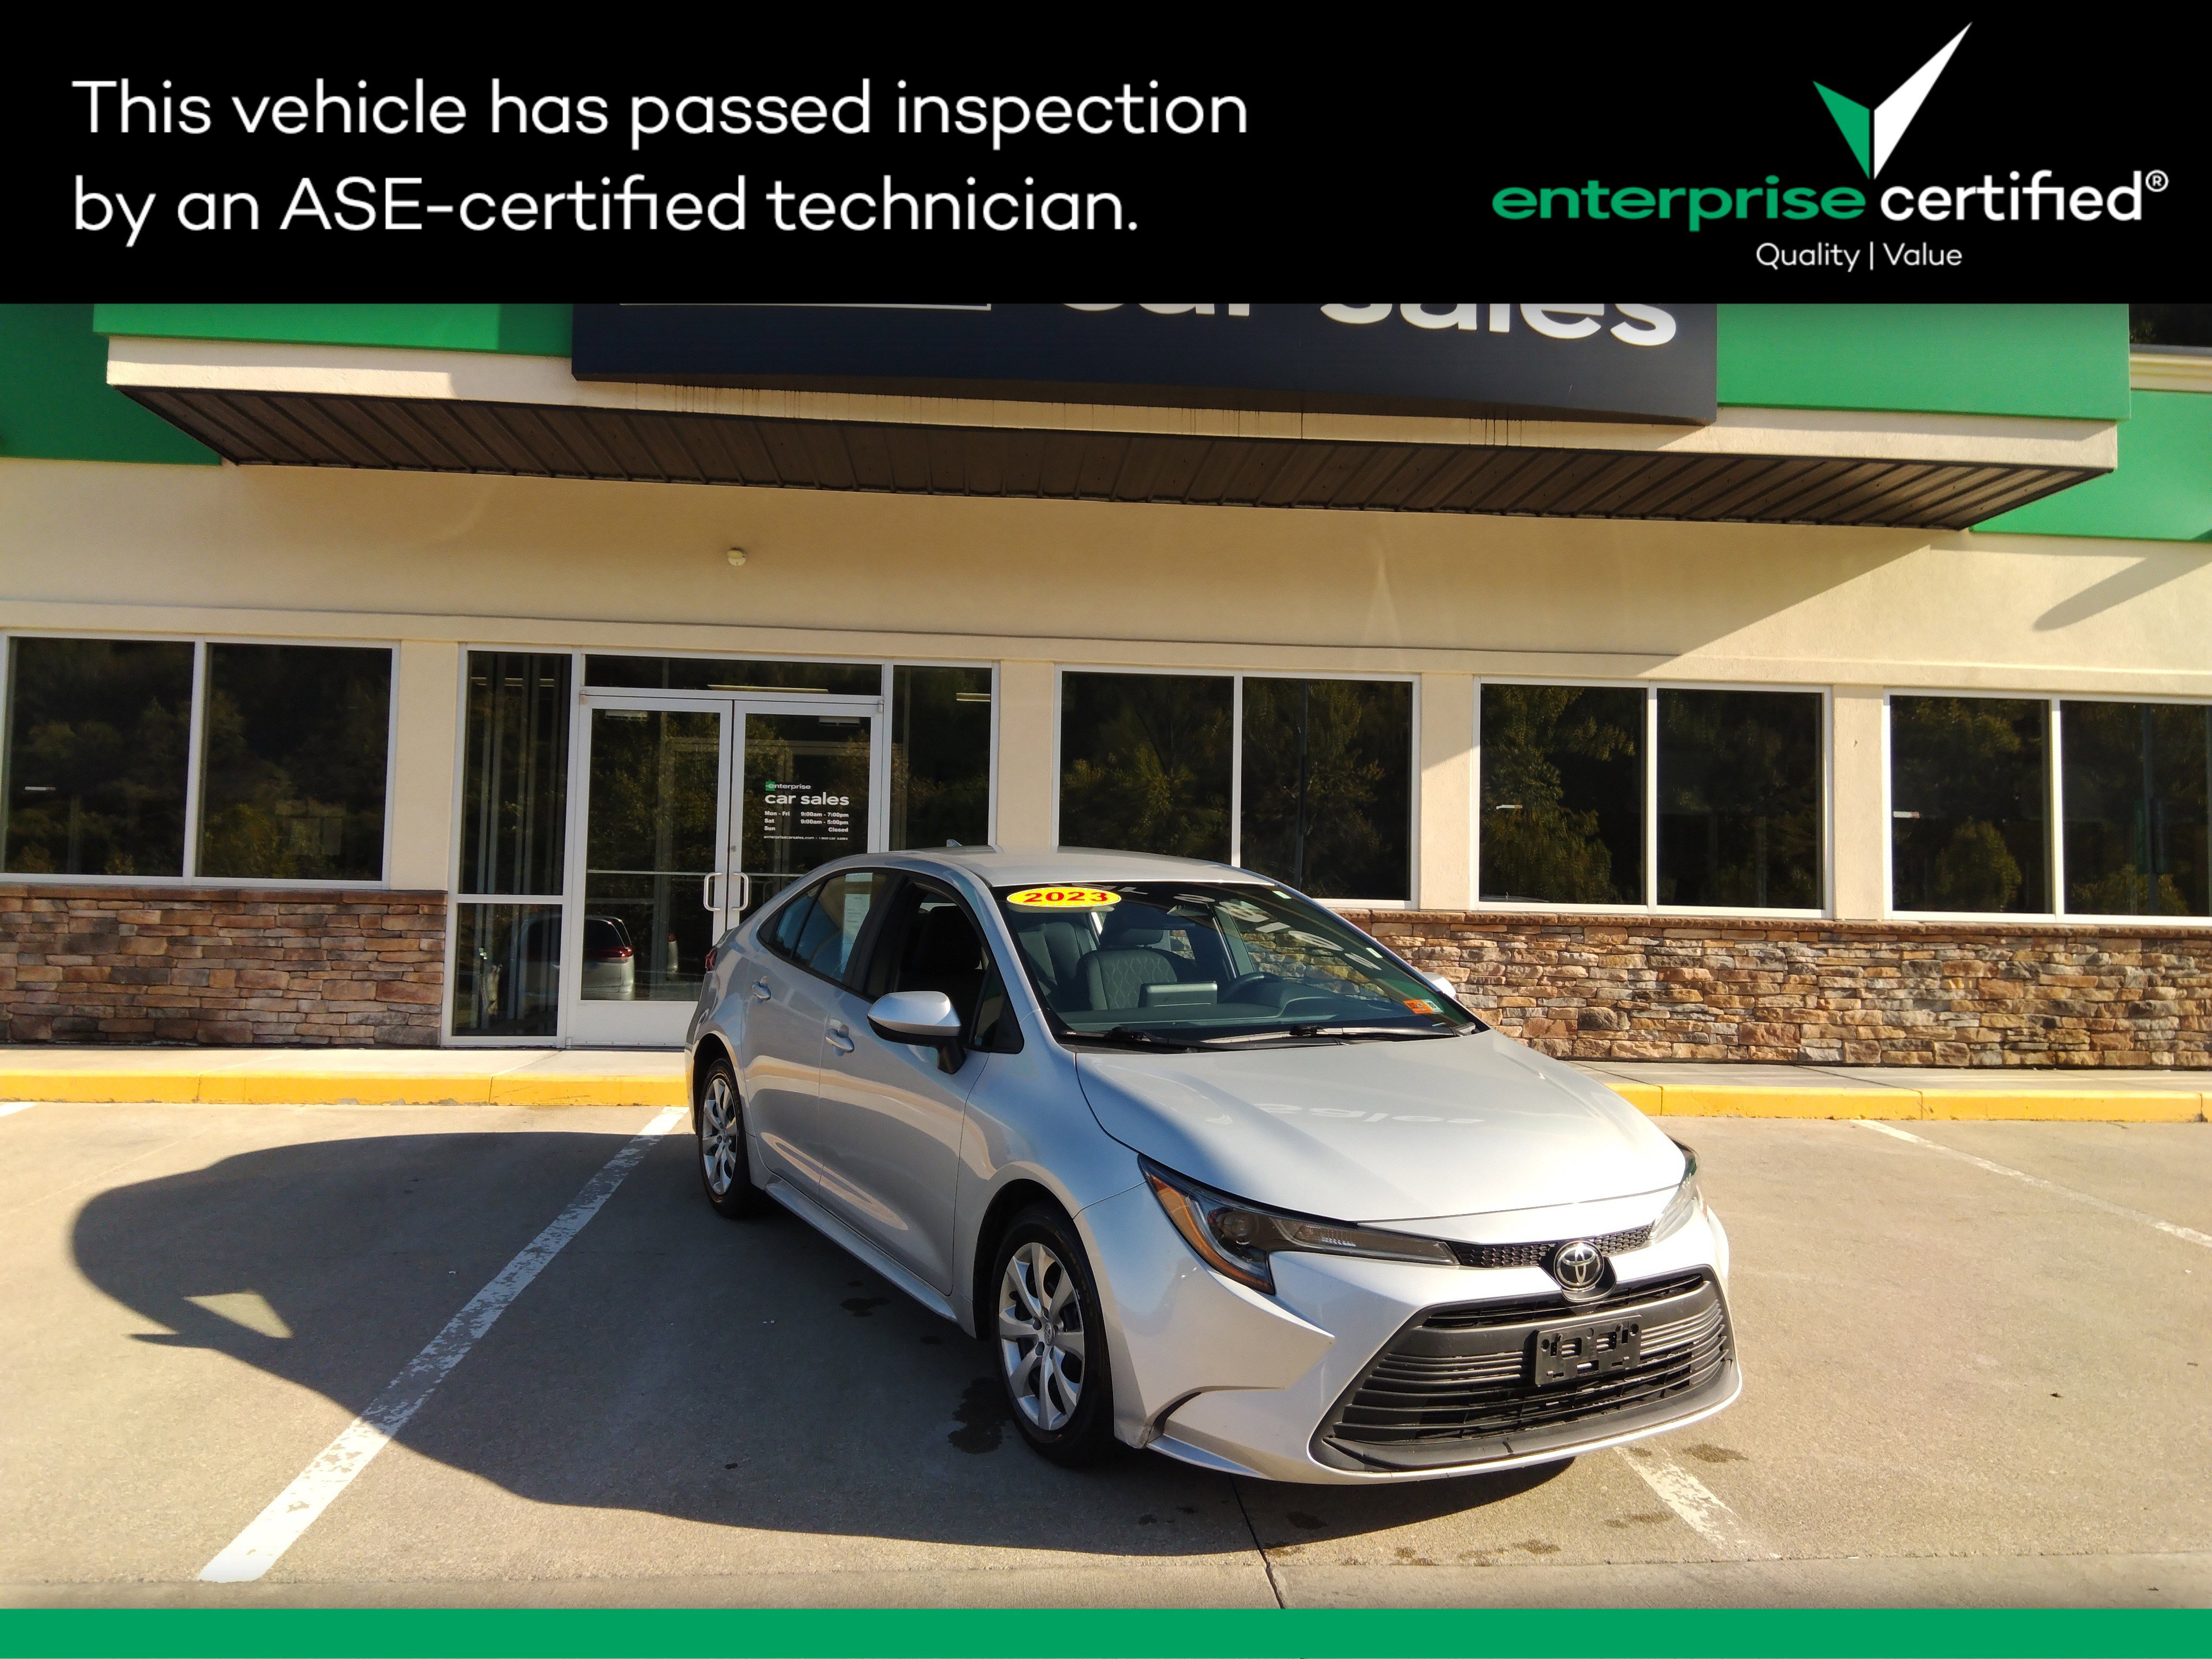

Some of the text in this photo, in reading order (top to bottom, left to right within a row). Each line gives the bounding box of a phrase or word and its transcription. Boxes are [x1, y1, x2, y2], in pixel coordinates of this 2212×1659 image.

[765, 792, 849, 805] car sales
[1023, 892, 1108, 902] 2023
